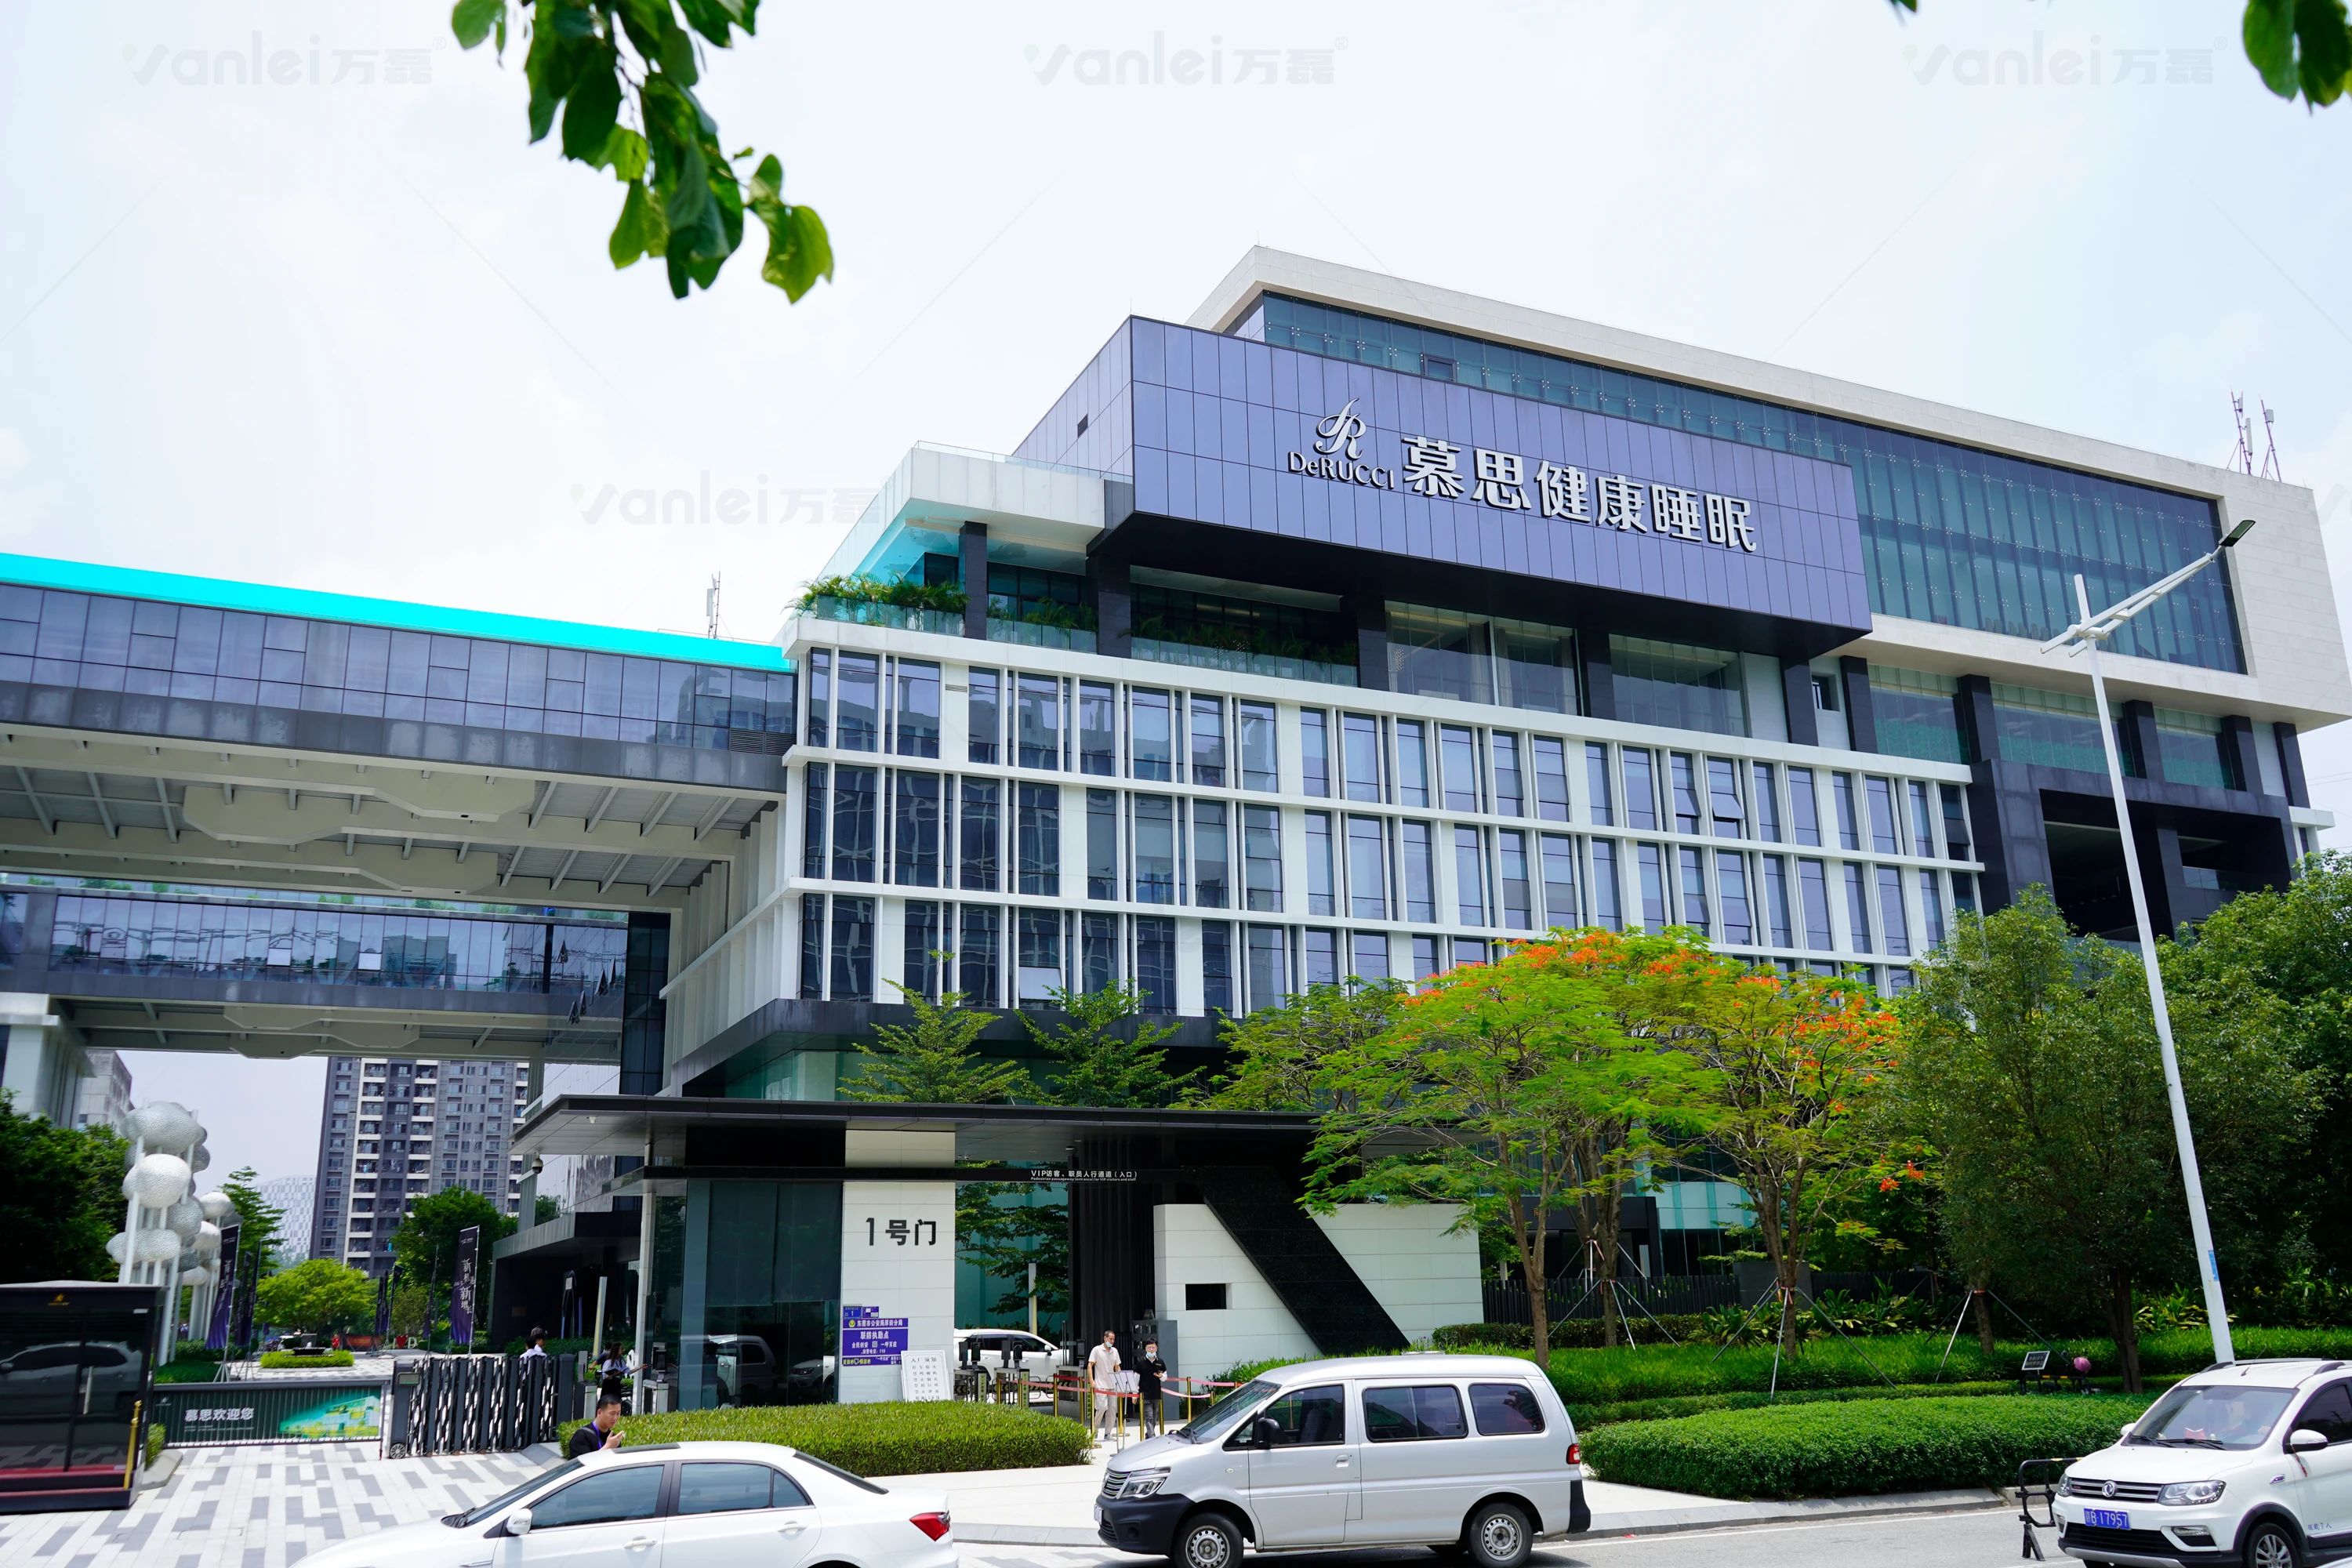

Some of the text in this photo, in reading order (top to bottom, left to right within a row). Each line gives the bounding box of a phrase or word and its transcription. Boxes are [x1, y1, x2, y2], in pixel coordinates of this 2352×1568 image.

[1288, 451, 1395, 489] DeRUCCI
[1402, 436, 1757, 552] 慕思健康睡眠
[866, 1217, 937, 1246] 1号门
[184, 1407, 255, 1422] 慕思欢迎您
